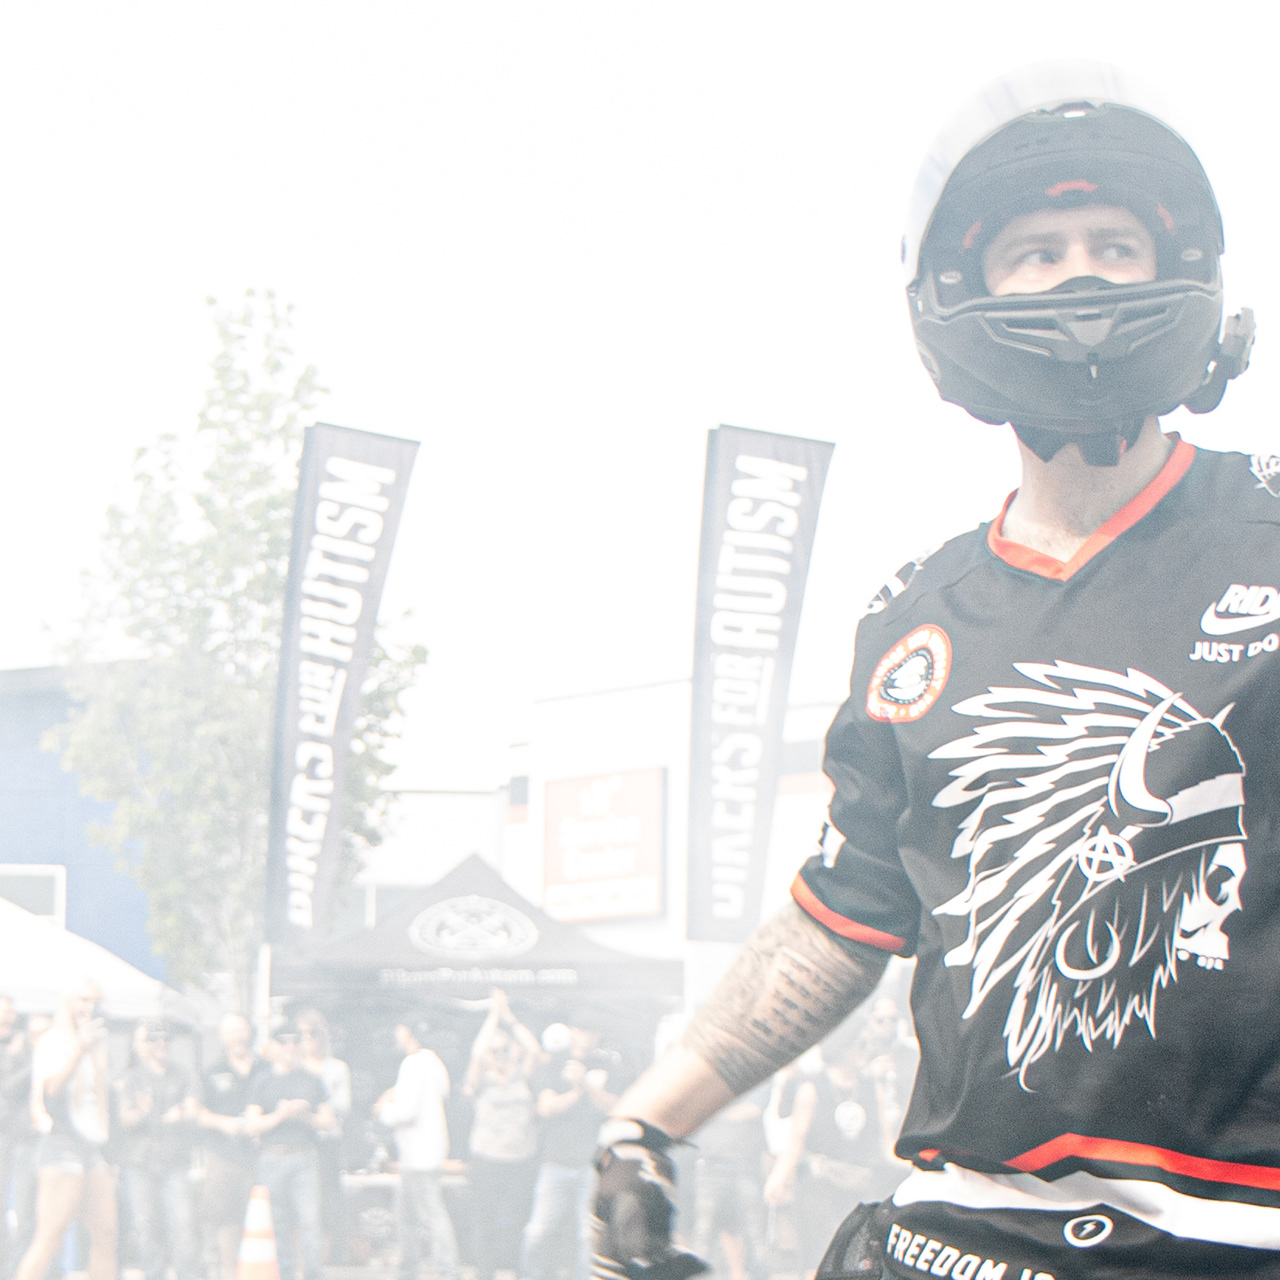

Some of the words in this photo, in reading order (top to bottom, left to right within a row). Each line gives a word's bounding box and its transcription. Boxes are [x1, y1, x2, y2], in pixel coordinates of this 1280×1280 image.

[299, 455, 396, 663] AUTISM
[710, 454, 809, 650] AUTISM
[1189, 641, 1244, 664] JUST
[1246, 632, 1280, 658] DO
